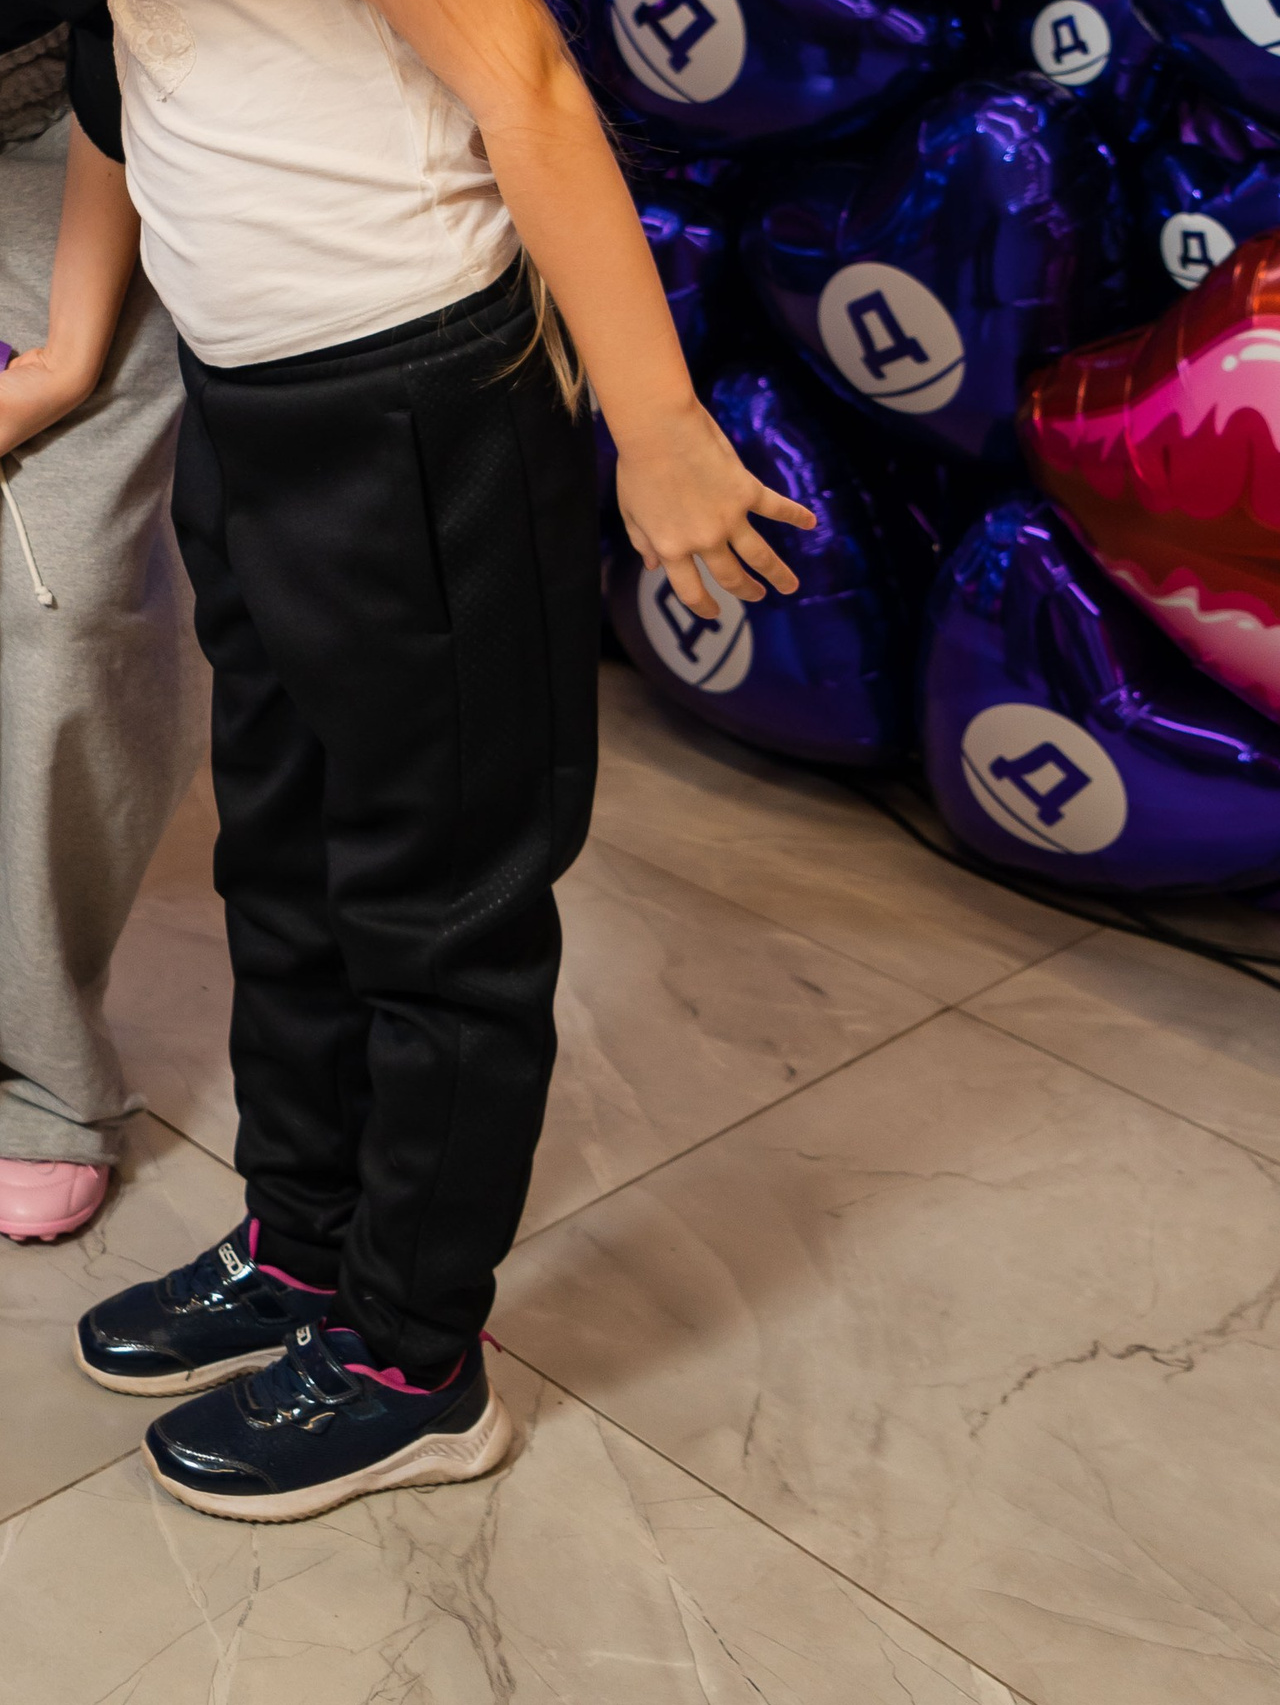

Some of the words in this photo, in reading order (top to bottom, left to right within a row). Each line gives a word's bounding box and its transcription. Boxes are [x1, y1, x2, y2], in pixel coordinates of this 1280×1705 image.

[1053, 16, 1087, 64] Д
[1181, 231, 1214, 268] Д
[848, 291, 928, 380] Д
[990, 742, 1092, 827] Д
